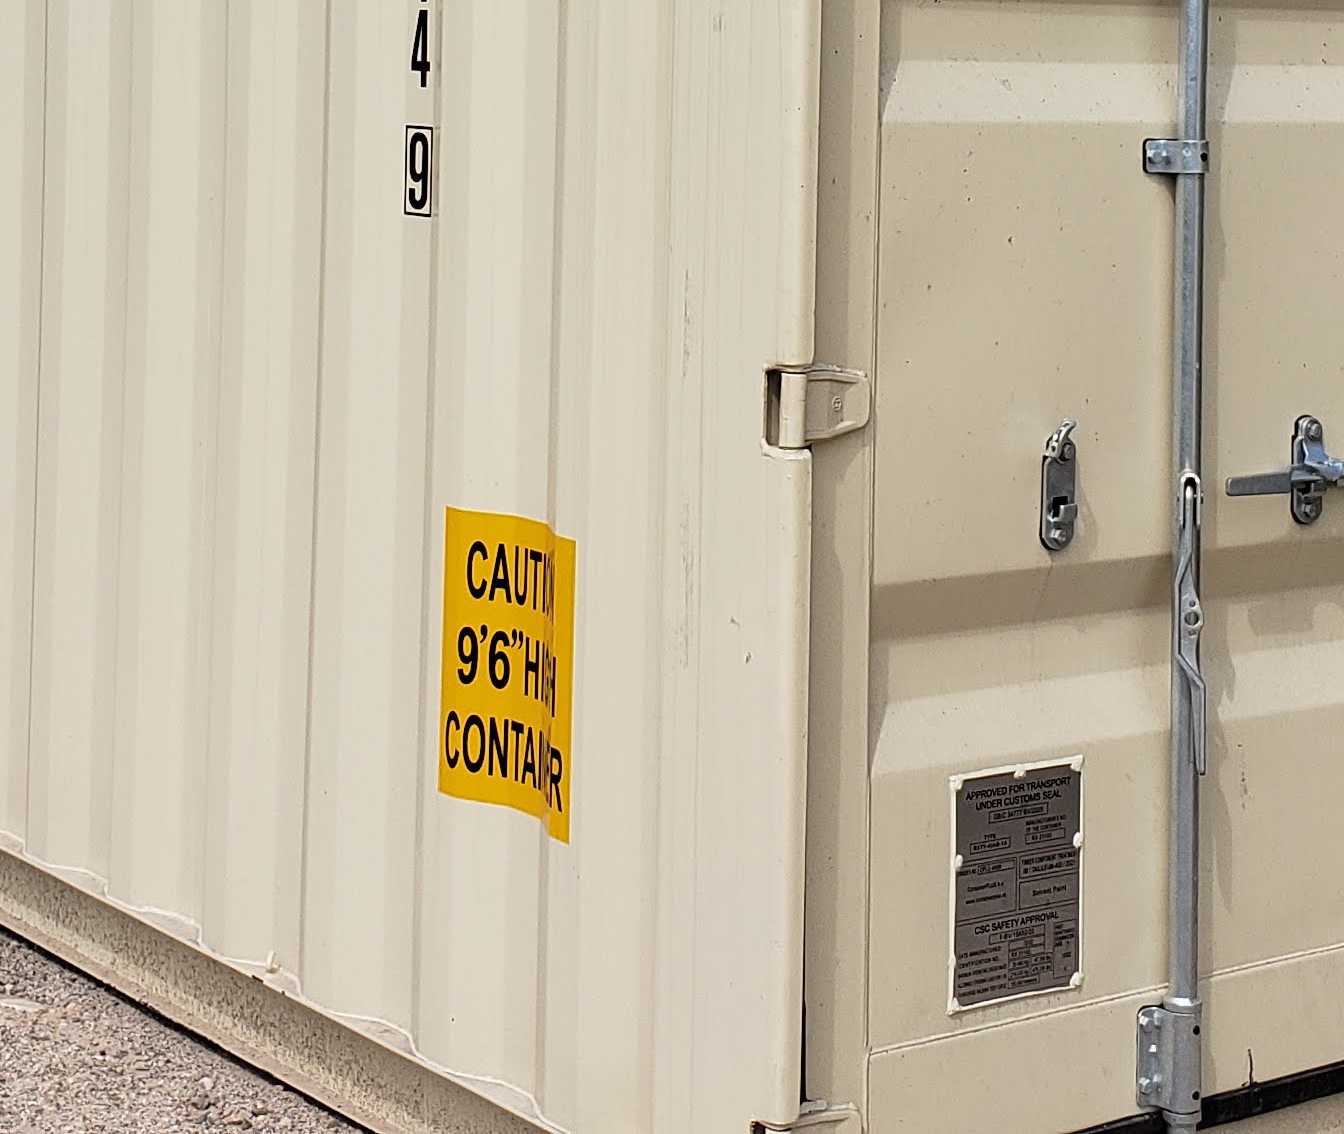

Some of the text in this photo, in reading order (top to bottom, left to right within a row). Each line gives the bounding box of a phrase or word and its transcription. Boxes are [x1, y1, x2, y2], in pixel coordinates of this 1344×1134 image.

[408, 131, 430, 211] 9
[966, 776, 1071, 801] APPROVED FOR TRANSPORT
[975, 789, 1062, 811] UNDER CUSTOMS SEAL
[974, 924, 990, 935] CSC
[991, 918, 1020, 932] SAFETY
[1020, 911, 1059, 927] APPROVAL
